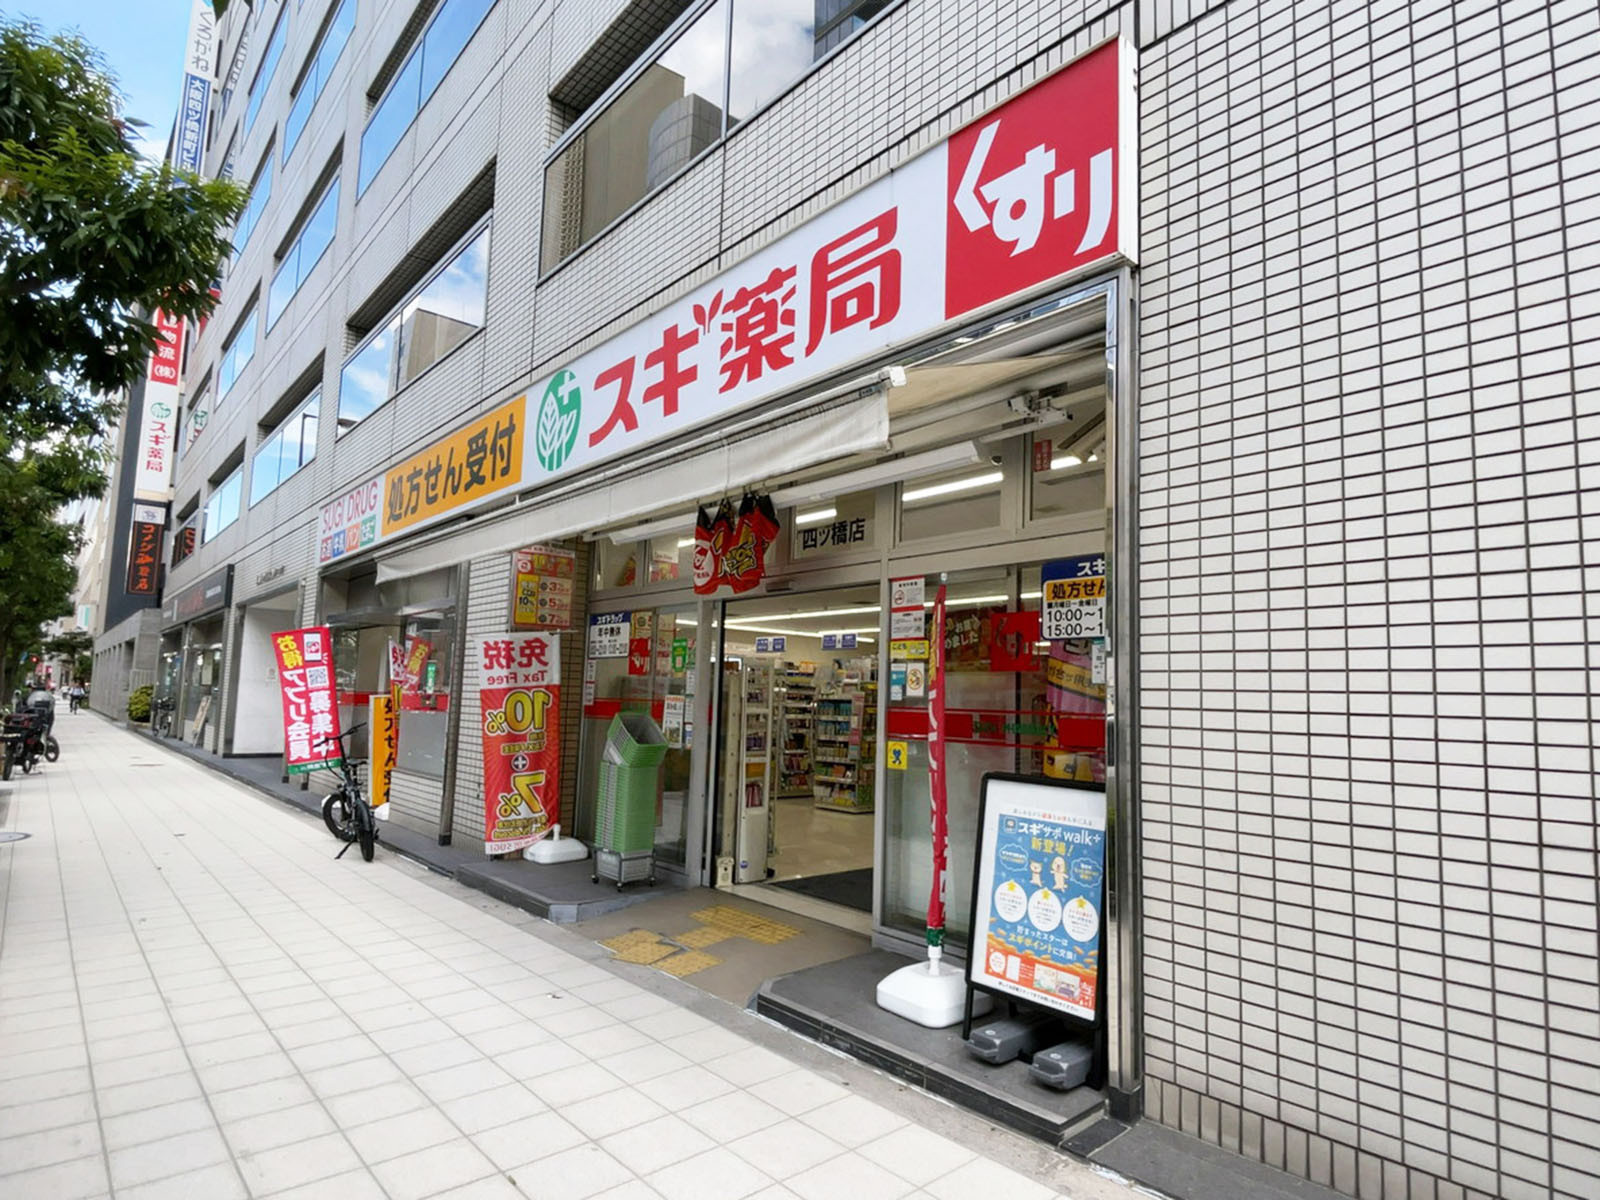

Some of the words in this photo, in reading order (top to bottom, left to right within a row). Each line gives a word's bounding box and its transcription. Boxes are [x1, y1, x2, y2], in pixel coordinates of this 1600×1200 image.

[192, 12, 212, 73] くろがね
[954, 119, 1112, 257] くすり
[588, 206, 902, 448] スギ薬局
[146, 420, 171, 473] スギ薬局
[387, 413, 516, 525] 処方せん受付
[322, 499, 344, 534] SUGI
[346, 481, 378, 523] DRUG
[802, 517, 866, 550] 四ツ橋店
